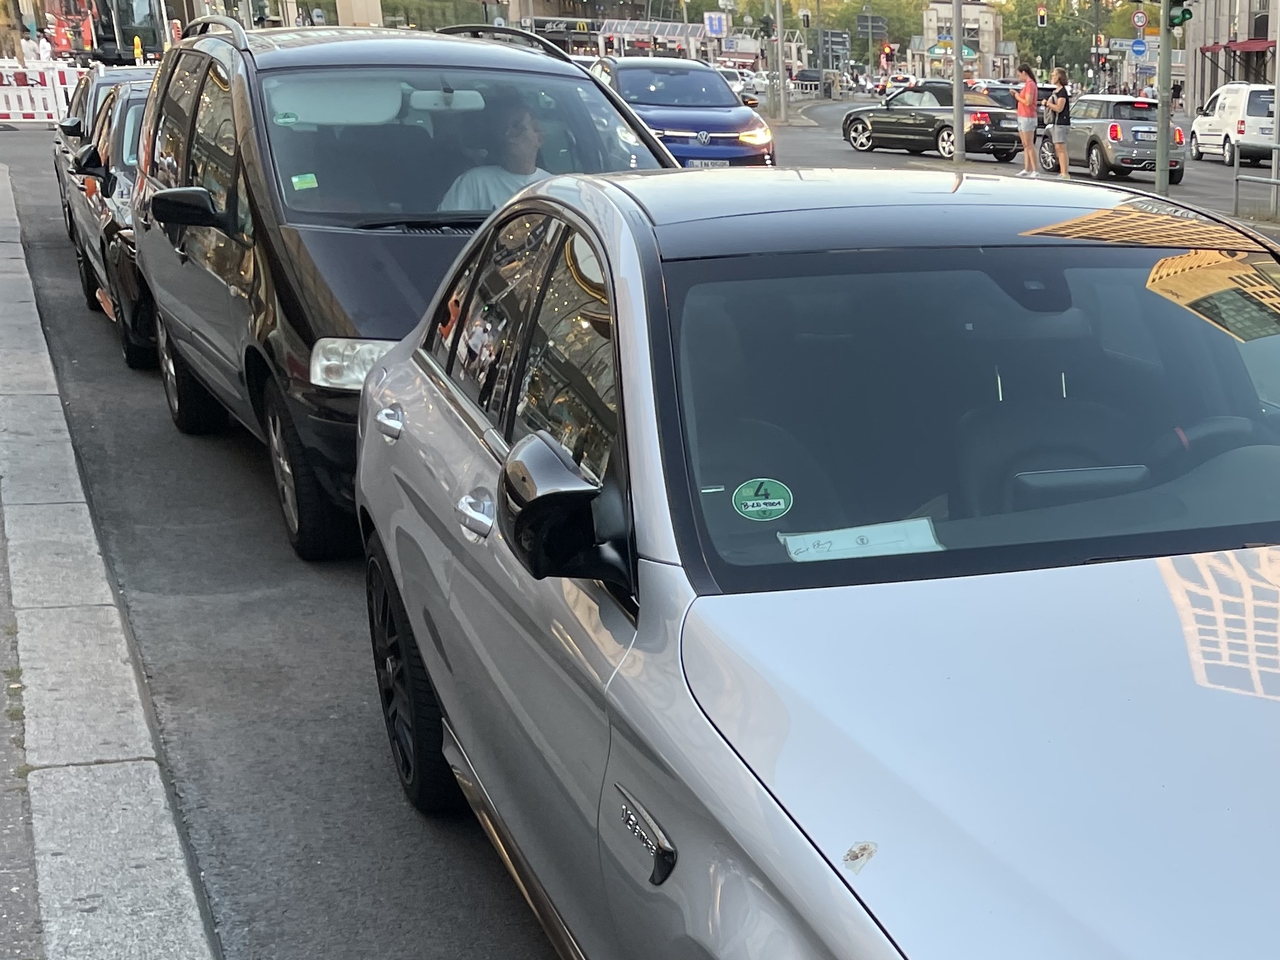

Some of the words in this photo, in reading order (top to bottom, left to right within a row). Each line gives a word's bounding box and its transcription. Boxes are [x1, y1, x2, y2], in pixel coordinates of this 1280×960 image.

[708, 15, 723, 34] U
[1136, 15, 1144, 23] 30
[754, 481, 770, 499] 4
